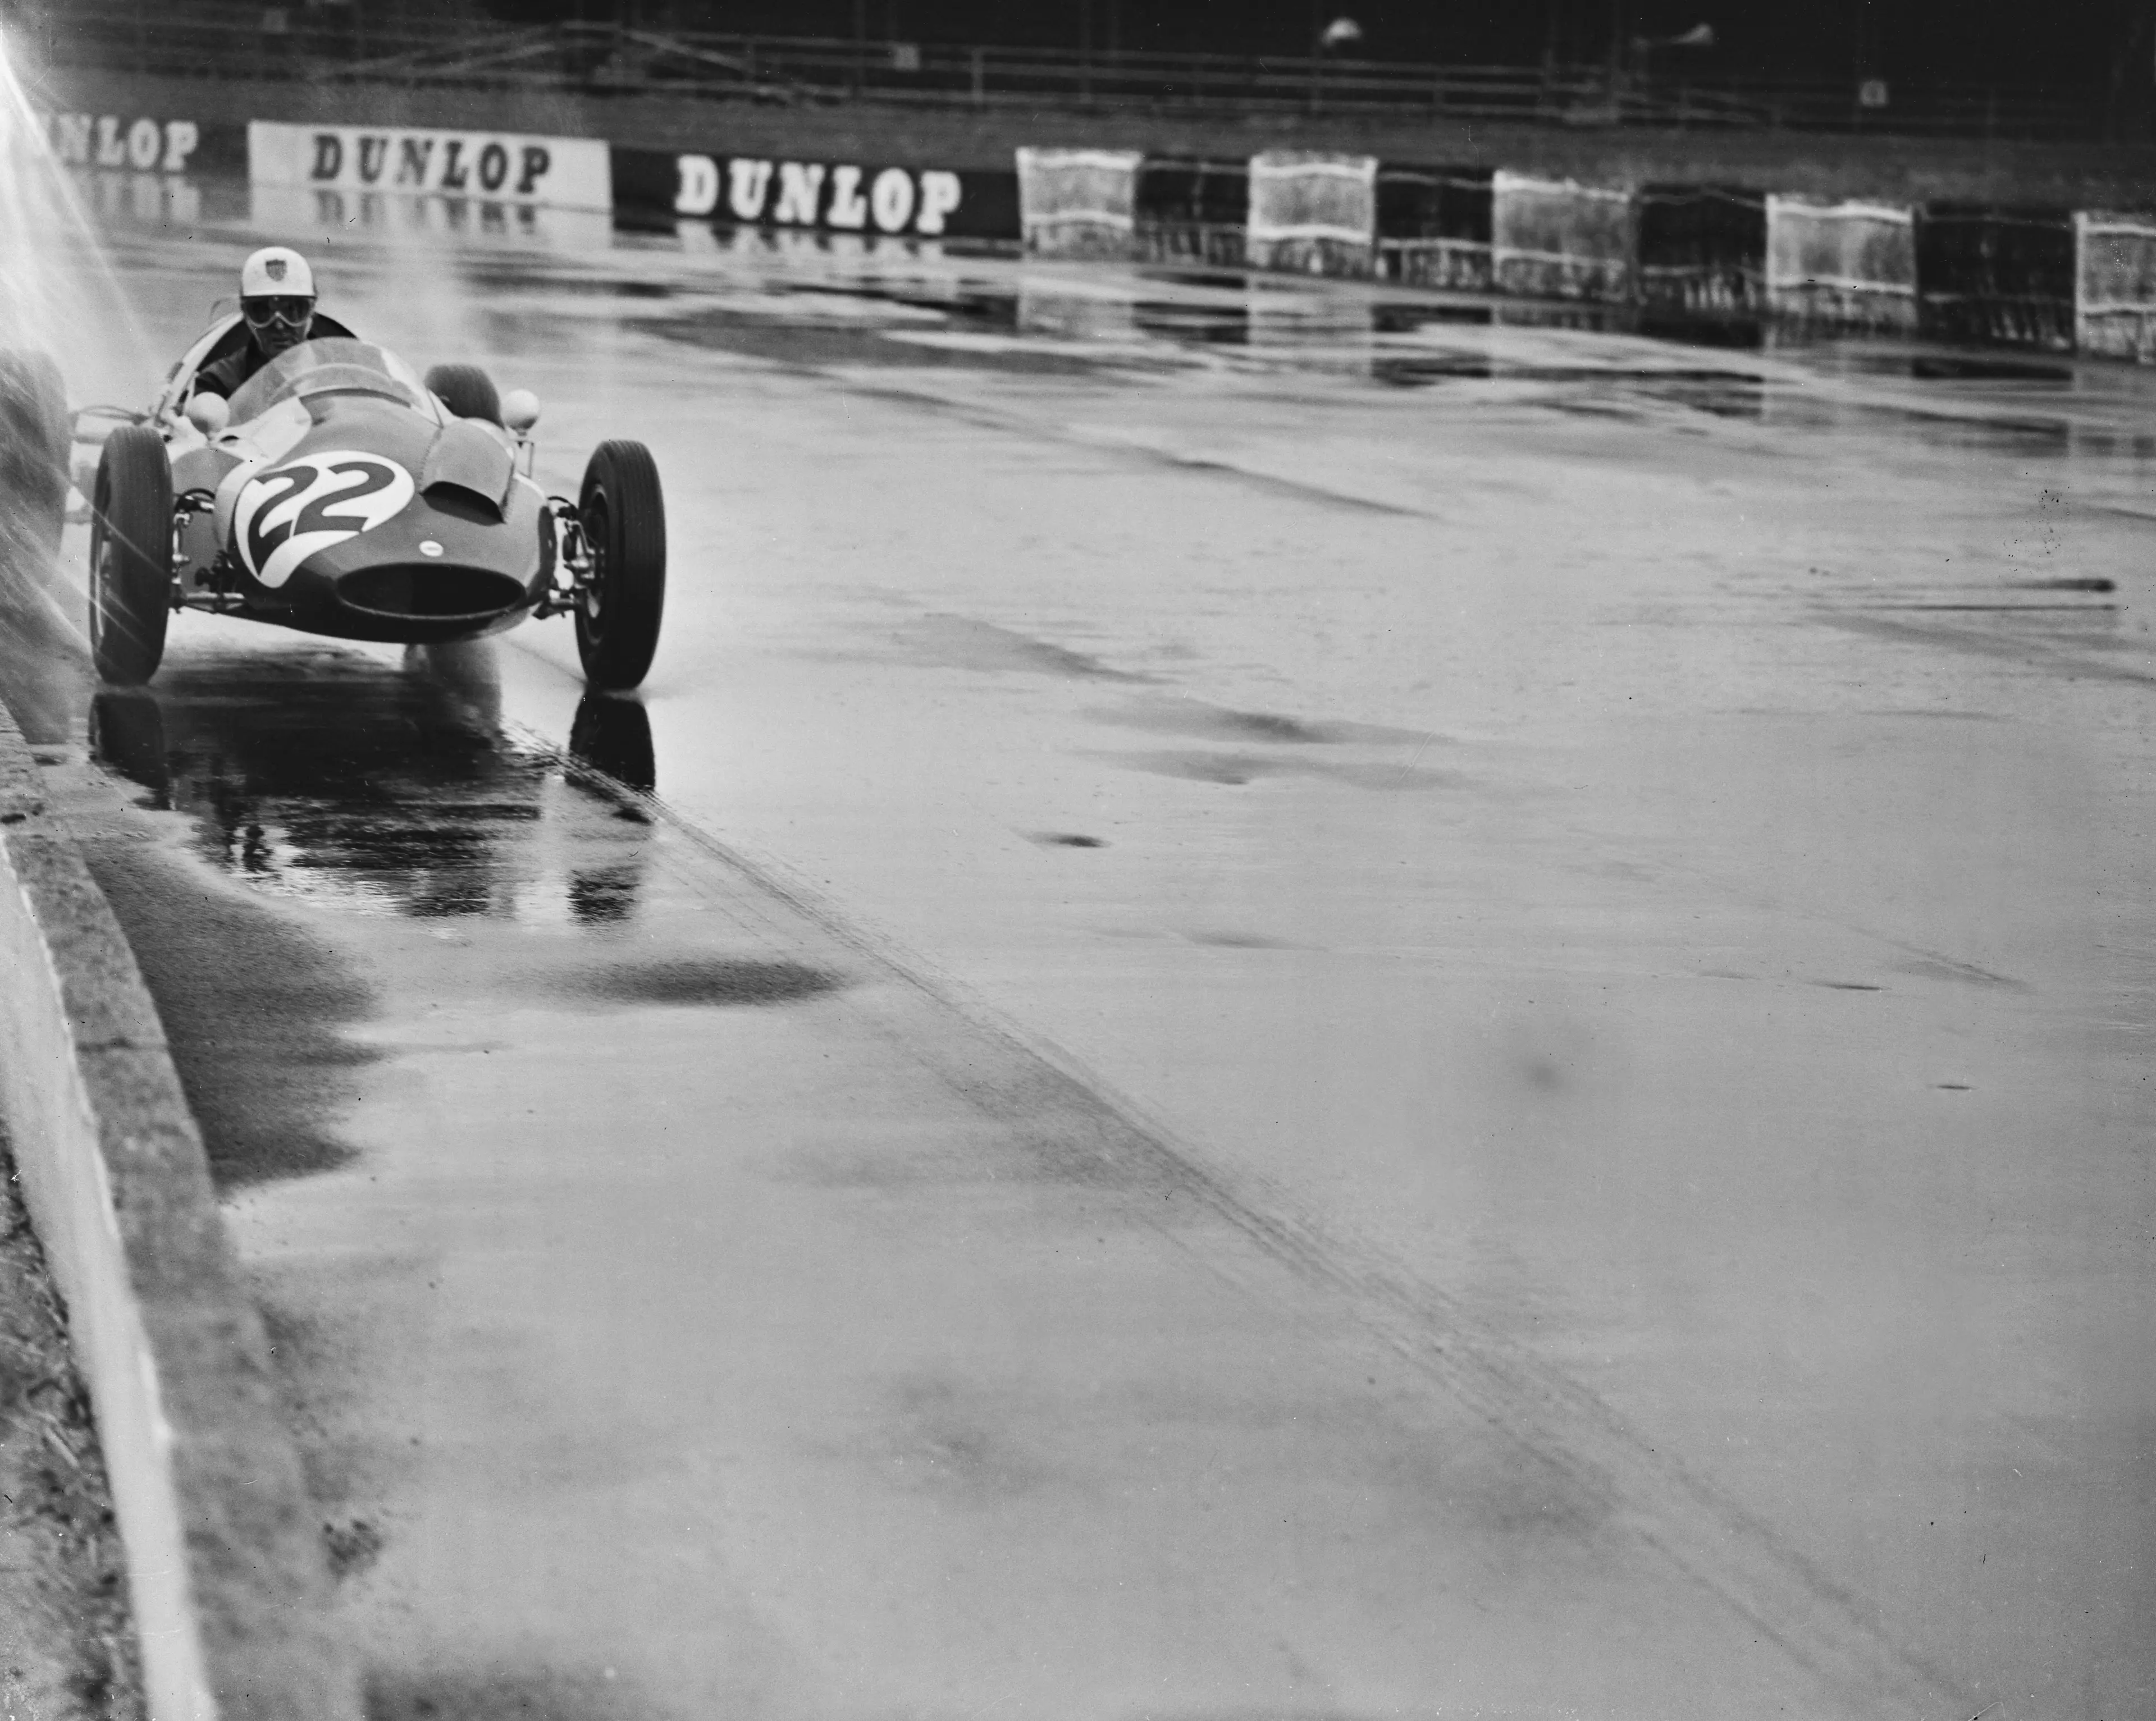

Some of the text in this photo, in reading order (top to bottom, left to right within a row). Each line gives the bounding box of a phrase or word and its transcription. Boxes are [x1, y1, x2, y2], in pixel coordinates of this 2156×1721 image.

[29, 115, 198, 170] NLOP
[310, 135, 550, 194] DUNLOP
[674, 154, 961, 234] DUNLOP
[248, 461, 395, 578] 22
